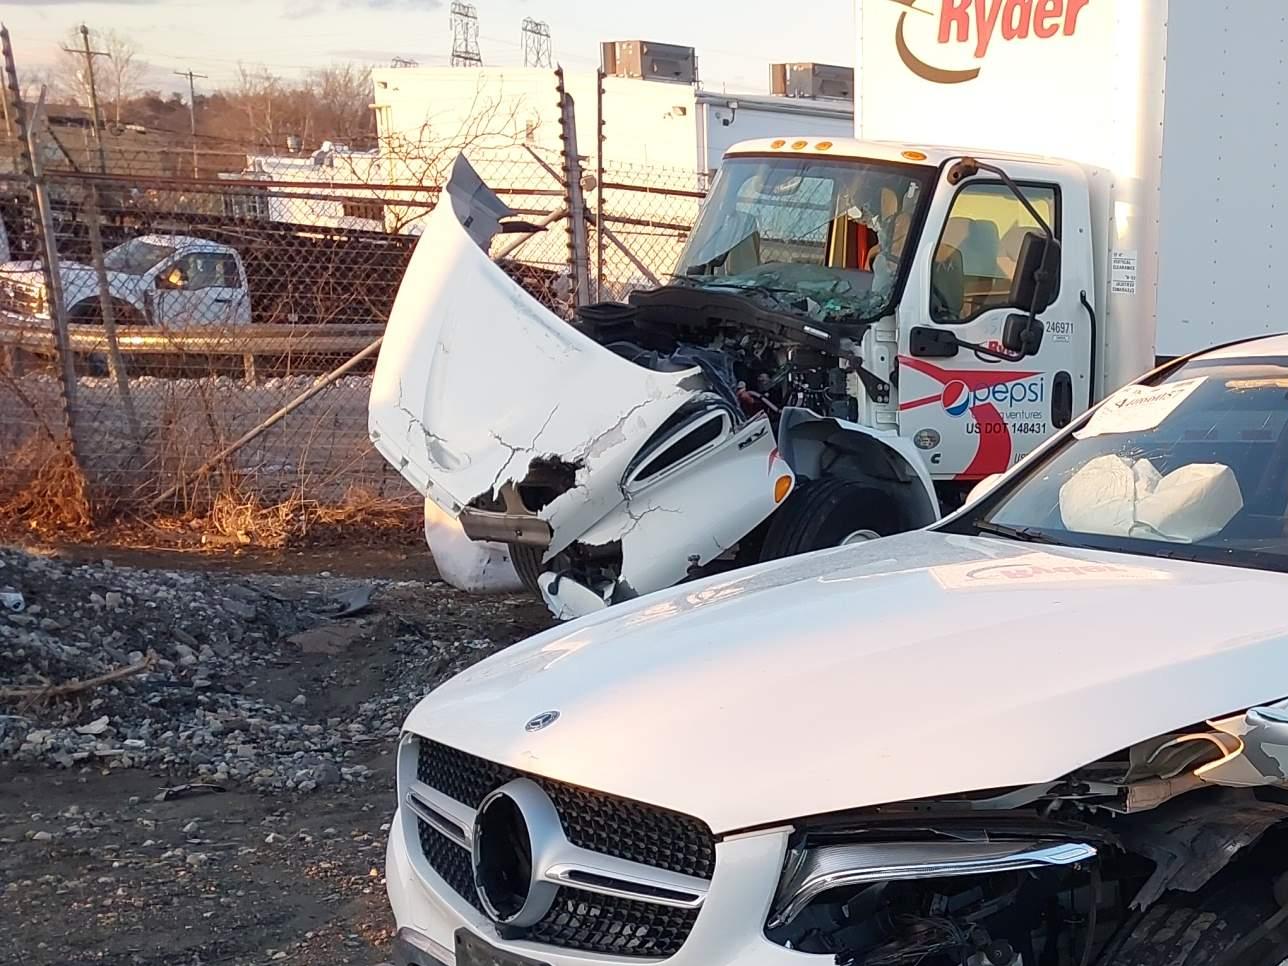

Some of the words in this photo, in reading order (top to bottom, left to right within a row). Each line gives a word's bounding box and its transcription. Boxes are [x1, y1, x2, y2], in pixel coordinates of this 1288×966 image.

[937, 0, 1090, 58] Ryder
[1045, 321, 1074, 334] 246971
[973, 377, 1045, 408] pepsi
[1005, 409, 1042, 420] ventures
[966, 423, 981, 434] US
[984, 423, 1008, 434] DOT
[1011, 423, 1046, 434] 148431
